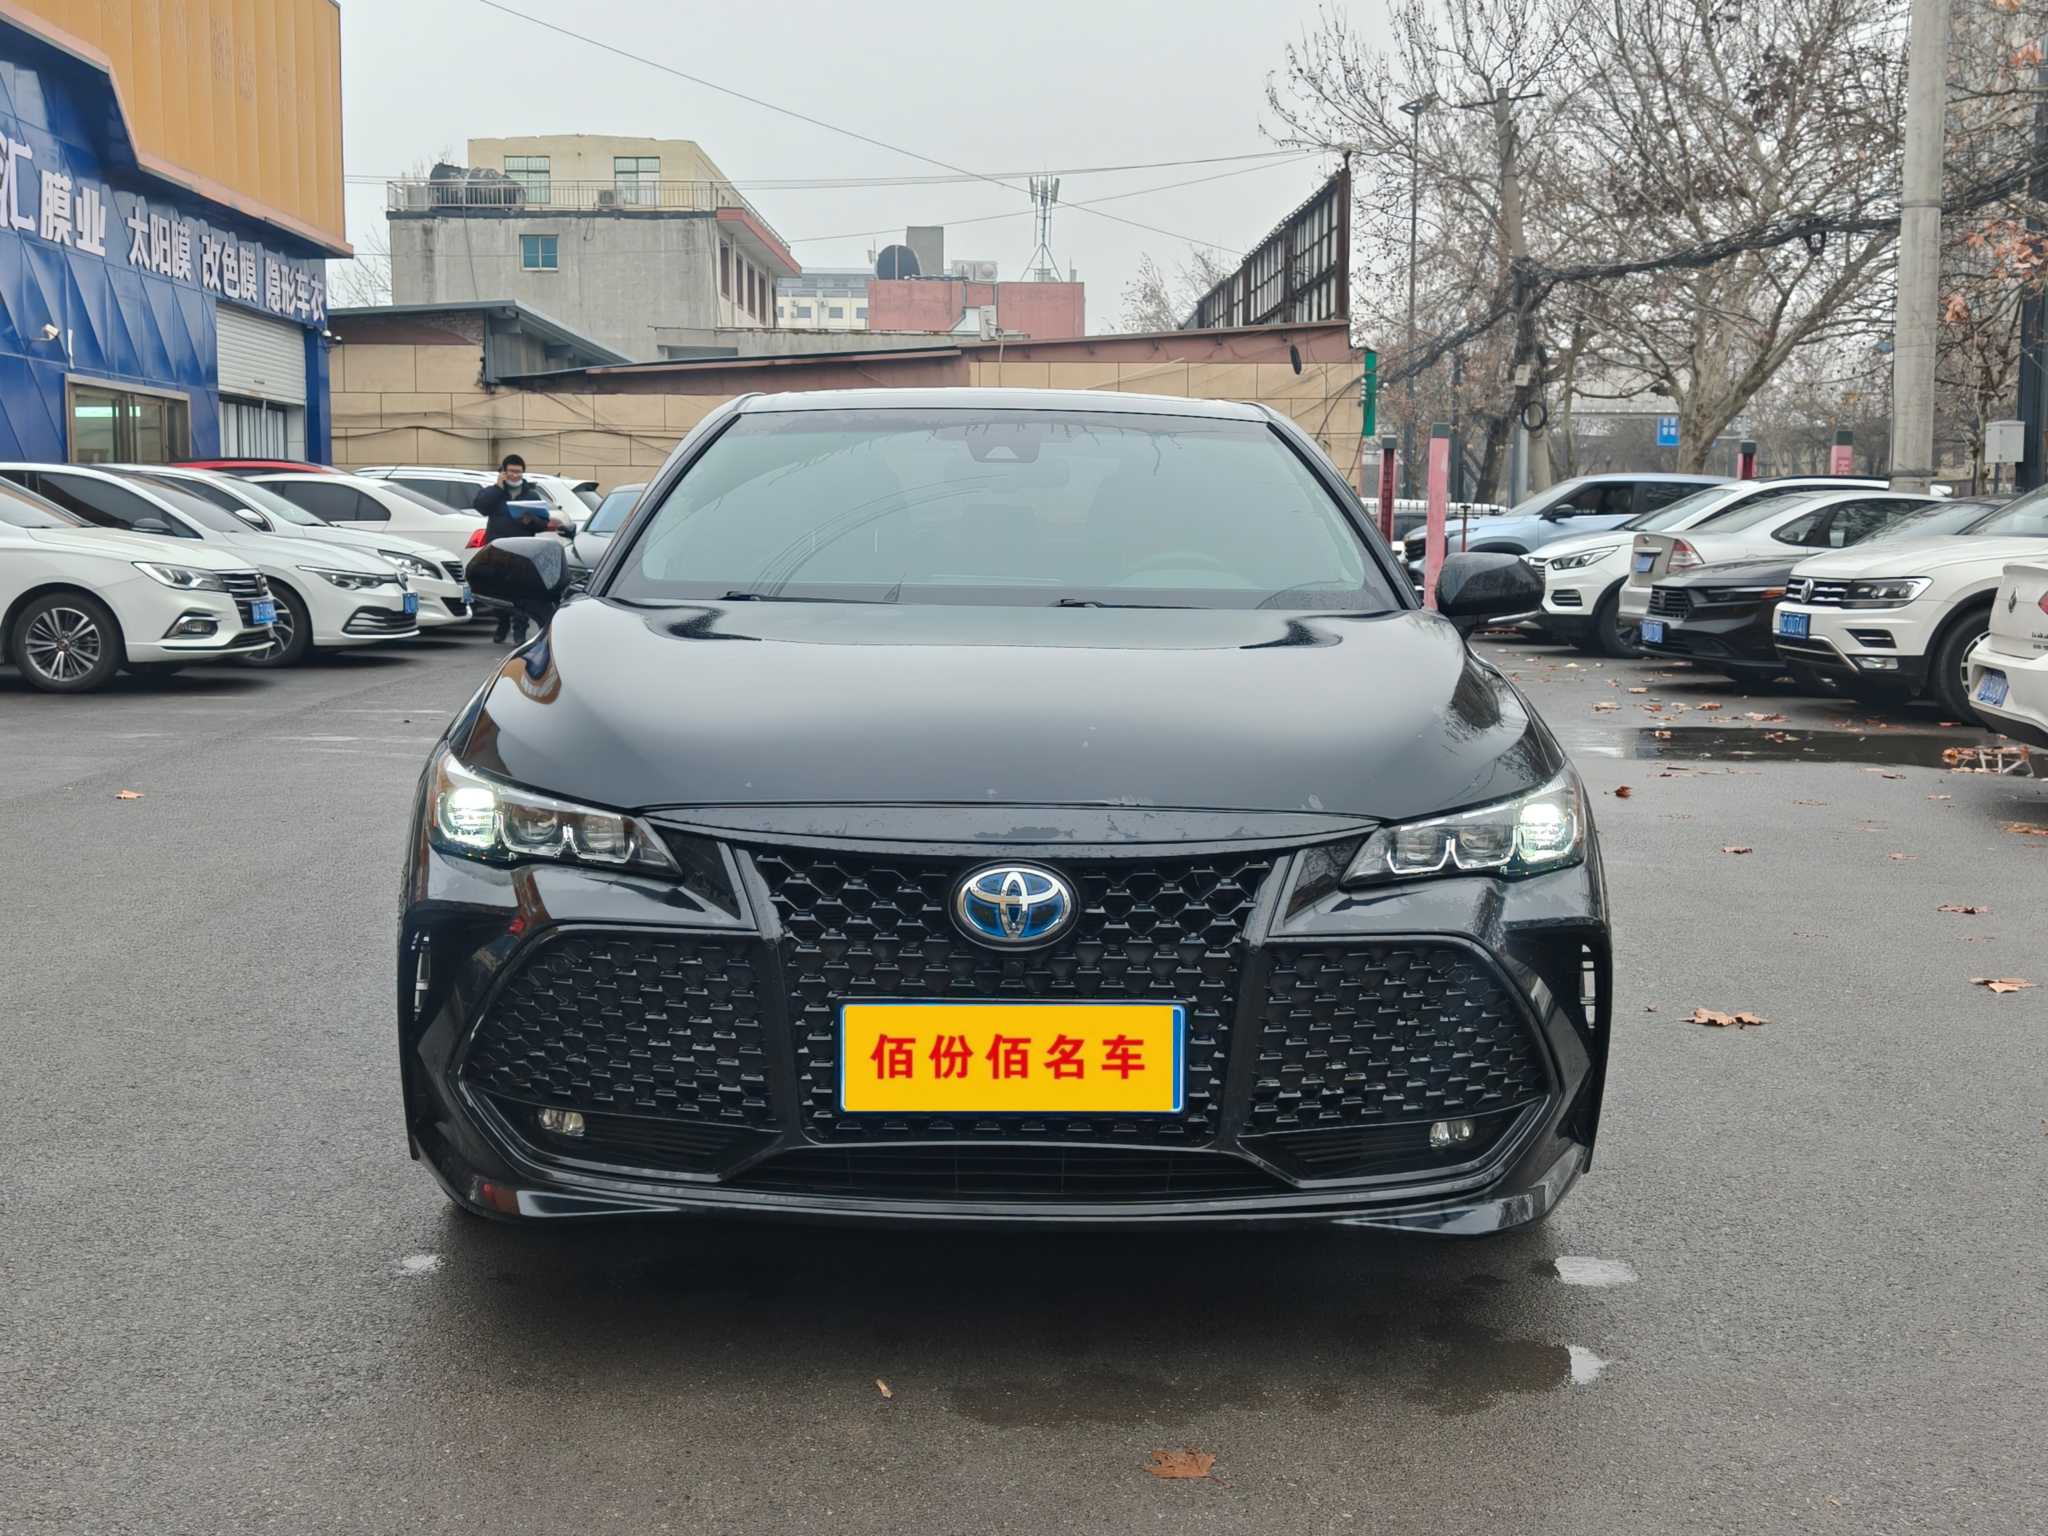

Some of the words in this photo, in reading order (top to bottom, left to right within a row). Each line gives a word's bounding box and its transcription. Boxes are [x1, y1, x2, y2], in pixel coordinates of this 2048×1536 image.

[127, 207, 191, 281] 太阳膜
[201, 235, 257, 302] 改色膜
[265, 257, 324, 321] 隐形车衣
